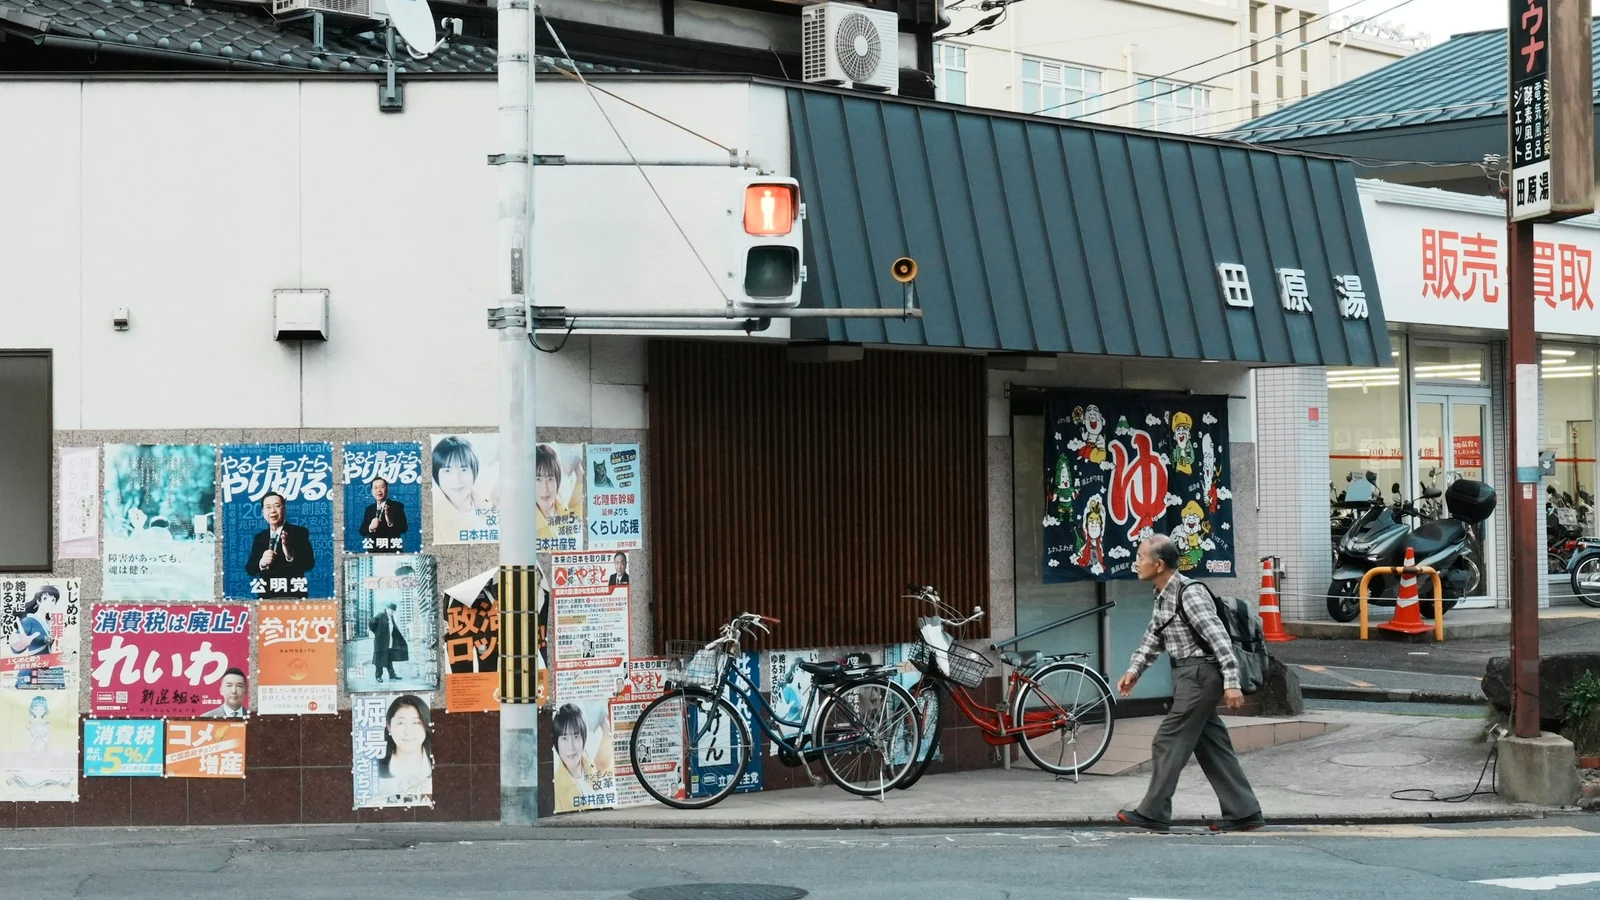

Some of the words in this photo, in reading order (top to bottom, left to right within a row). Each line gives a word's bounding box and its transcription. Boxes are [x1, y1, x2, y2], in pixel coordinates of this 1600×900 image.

[1521, 0, 1545, 73] ウナ
[1513, 87, 1523, 163] ジェット
[1534, 82, 1542, 158] 電気風呂
[1516, 171, 1549, 207] 田原湯
[1422, 228, 1499, 304] 販売
[1533, 240, 1594, 311] 買取
[1217, 262, 1369, 320] 田原湯
[220, 453, 334, 475] やると言ったら、
[342, 451, 422, 466] やると言ったら、
[342, 462, 423, 485] やり切る。
[220, 472, 335, 503] やり切る。
[1108, 429, 1169, 542] ゆ
[592, 493, 635, 506] 北陸新幹線
[474, 506, 499, 516] ホンモ
[486, 515, 499, 526] 改
[459, 530, 499, 541] 日本共産
[590, 519, 640, 536] くらし応援
[361, 537, 404, 549] 公明党
[536, 537, 577, 551] 日本共産党
[108, 553, 182, 564] 障害があっても、
[553, 554, 612, 565] 本来の日本を取り戻す
[249, 576, 308, 594] 公明党
[574, 565, 610, 586] やまと
[15, 580, 26, 611] 絶対に
[3, 580, 14, 645] ゆるさない!
[93, 609, 249, 634] 消費税は廃止!
[50, 612, 64, 651] 犯罪!
[258, 616, 334, 647] 参政党
[91, 635, 229, 688] れいわ
[631, 671, 664, 692] やまと
[139, 688, 188, 705] 新選組
[92, 724, 156, 746] 消費税
[169, 723, 215, 747] コメ
[99, 746, 155, 774] 5%!
[198, 750, 243, 775] 増産
[592, 777, 614, 791] 改革
[717, 771, 759, 787] 立憲主党
[573, 792, 616, 807] 日本共産党
